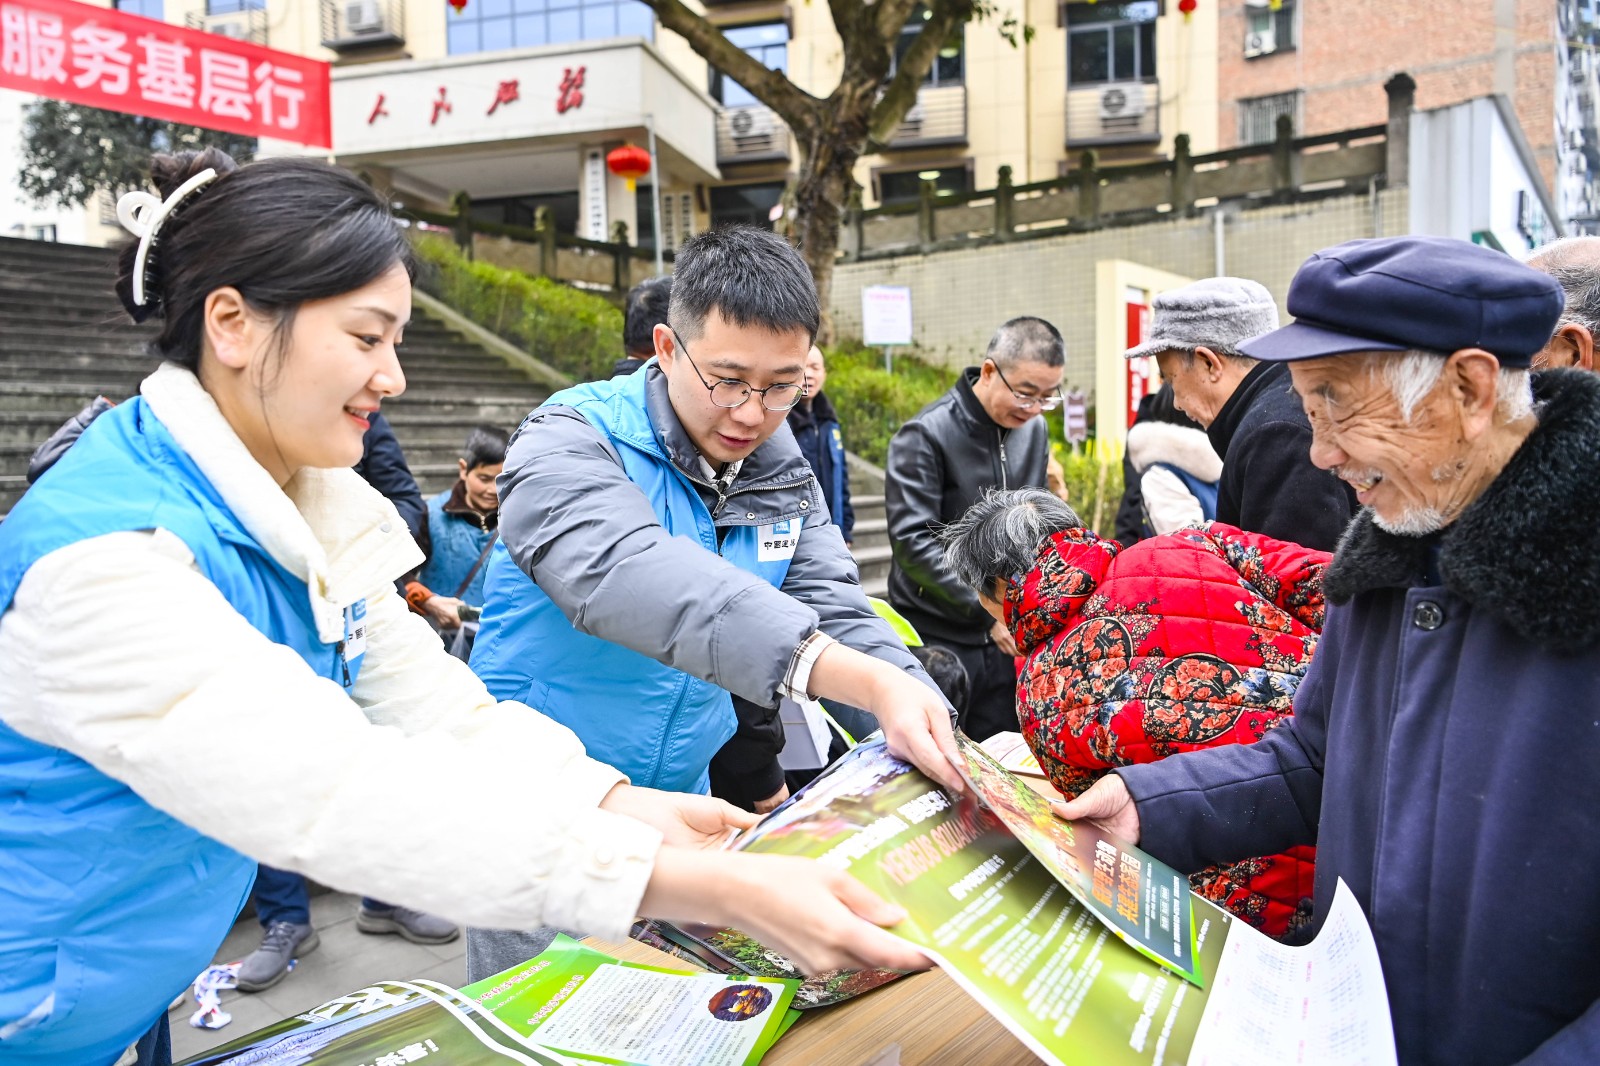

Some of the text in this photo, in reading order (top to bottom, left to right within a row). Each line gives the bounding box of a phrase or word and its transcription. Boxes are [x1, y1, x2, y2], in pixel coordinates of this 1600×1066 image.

[1, 4, 305, 130] 服务基层行
